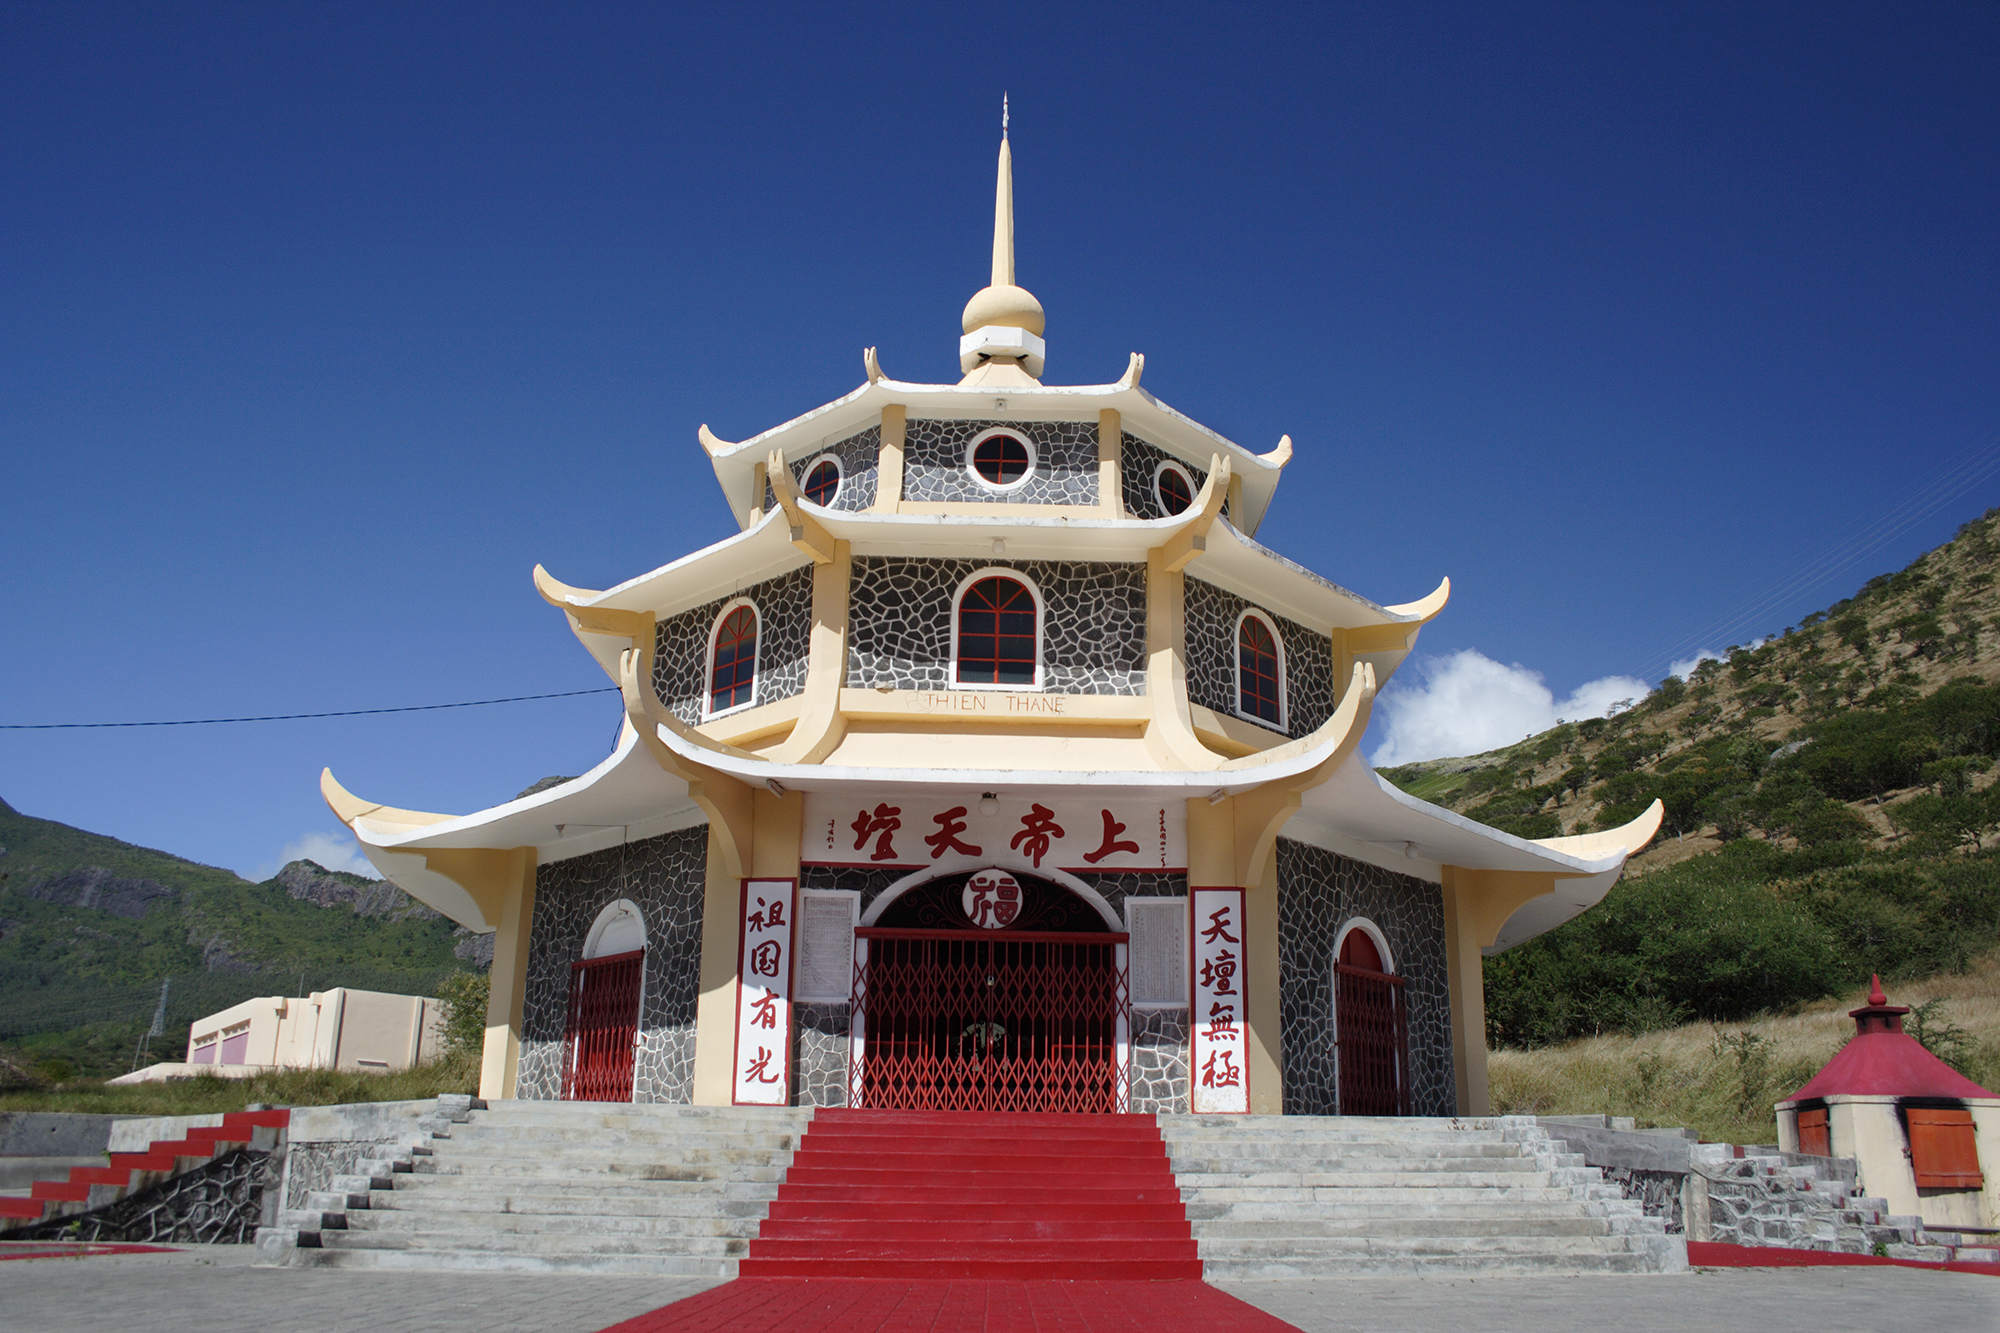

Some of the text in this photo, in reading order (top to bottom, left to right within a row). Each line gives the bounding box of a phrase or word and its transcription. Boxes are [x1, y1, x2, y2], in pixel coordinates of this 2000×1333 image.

[925, 693, 1066, 713] THIEN THANE
[969, 877, 1019, 926] 福
[1200, 906, 1241, 1090] 天壇無極
